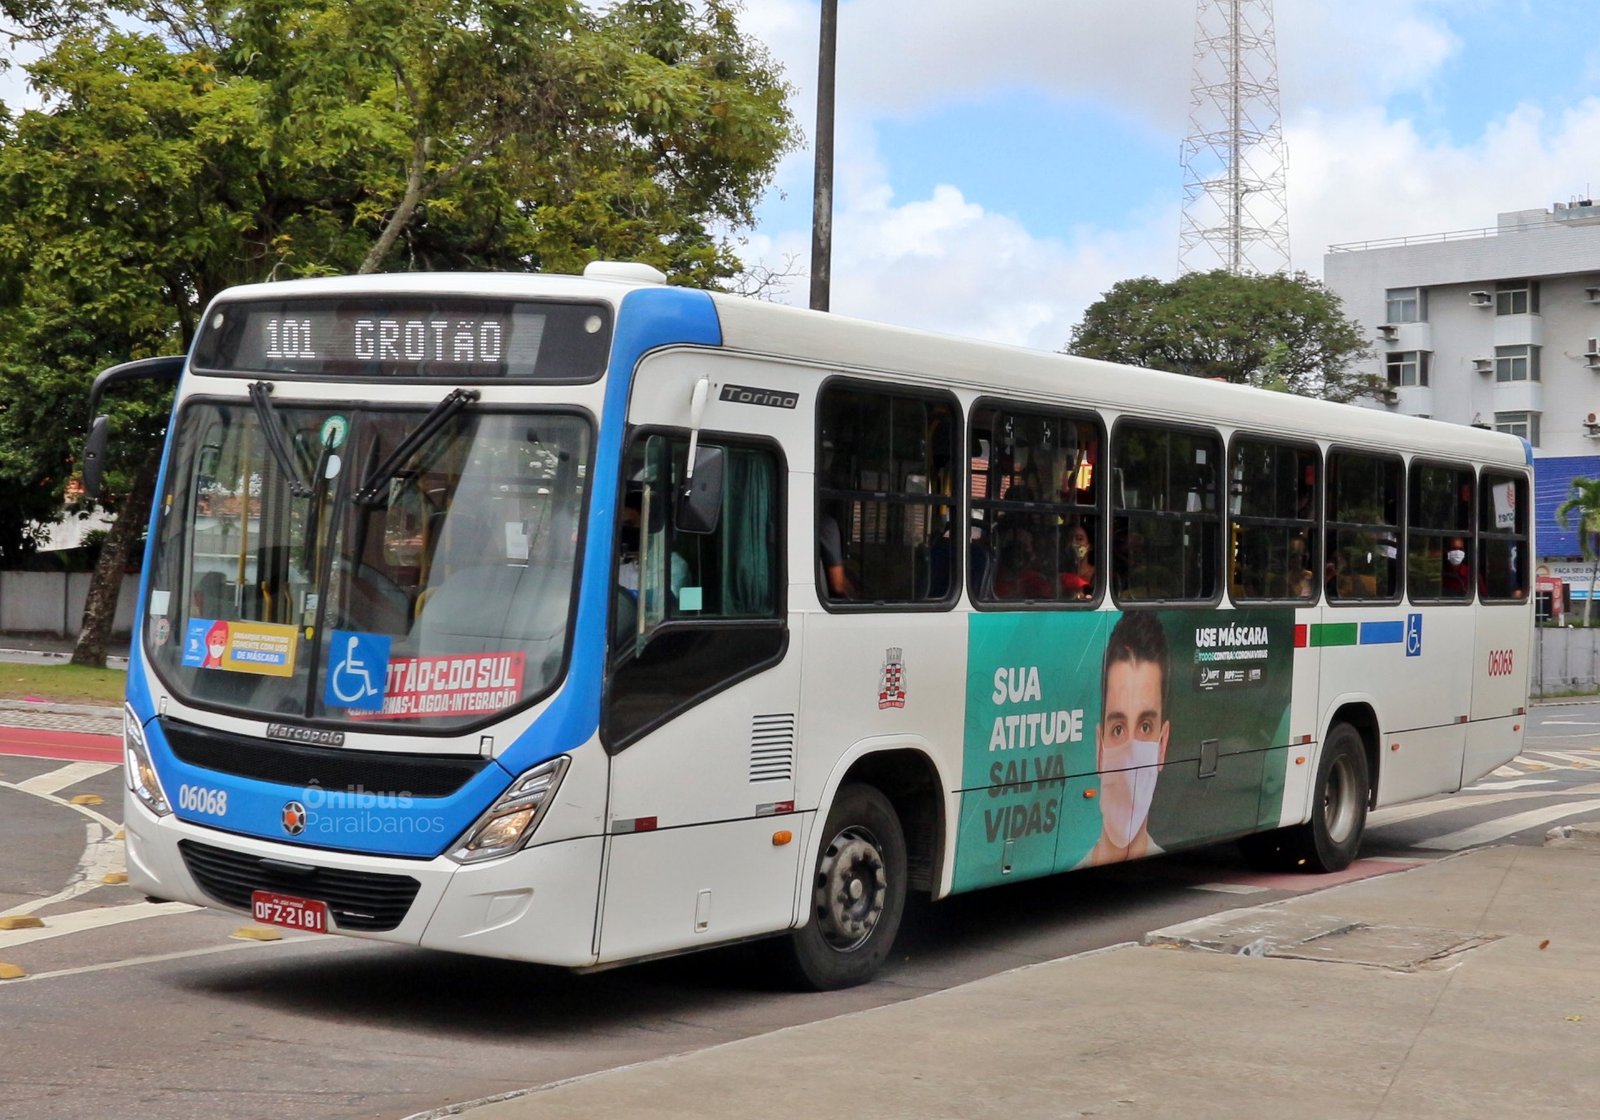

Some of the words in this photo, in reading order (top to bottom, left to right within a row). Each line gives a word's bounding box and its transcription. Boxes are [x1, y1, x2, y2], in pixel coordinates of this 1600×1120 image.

[266, 319, 315, 358] 101
[724, 386, 796, 407] Torino
[1196, 627, 1217, 647] USE
[1218, 622, 1269, 647] MÁSCARA
[236, 650, 247, 660] DE
[247, 650, 279, 663] MÁSCARA
[476, 656, 516, 688] SUL
[1488, 649, 1513, 676] 06068
[992, 666, 1041, 705] SUA
[267, 723, 343, 744] Marcopolo
[989, 709, 1084, 751] ATITUDE
[987, 754, 1066, 799] SALVA
[179, 783, 227, 816] 06068
[984, 799, 1058, 843] VIDAS
